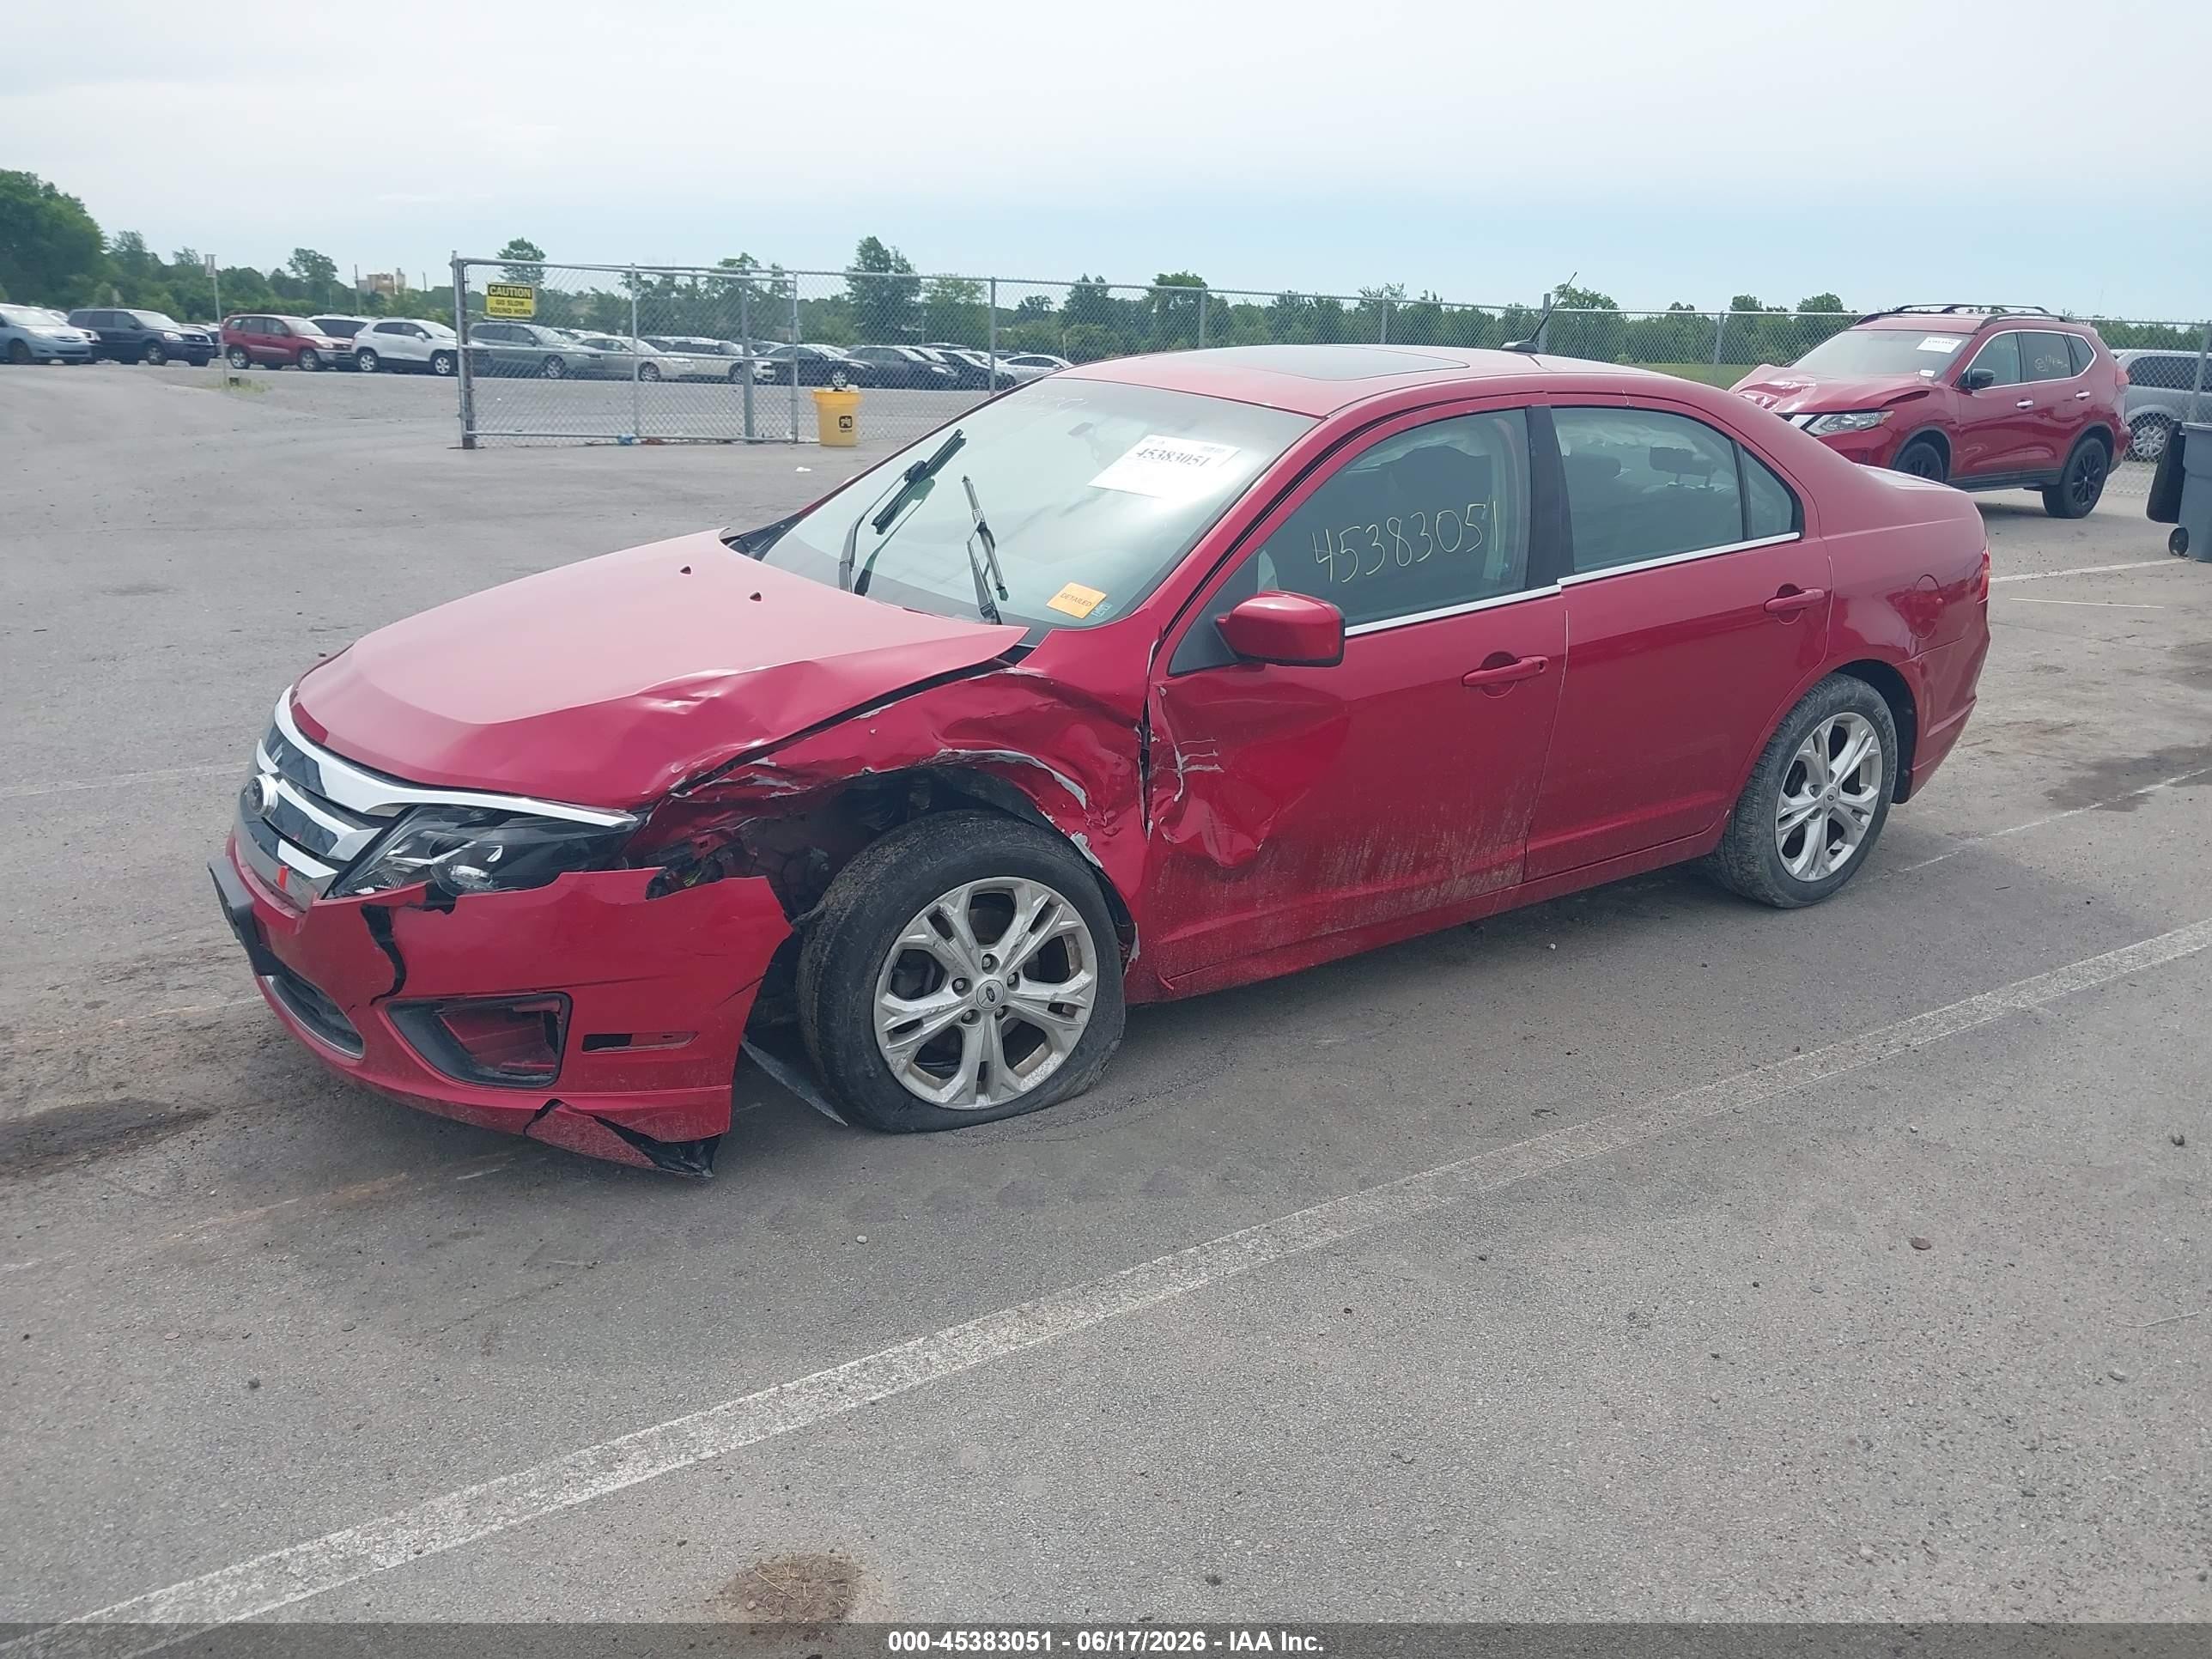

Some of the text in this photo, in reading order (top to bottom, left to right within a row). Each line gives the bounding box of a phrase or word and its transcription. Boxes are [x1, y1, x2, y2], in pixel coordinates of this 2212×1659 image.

[489, 286, 531, 298] CAUTION
[1137, 447, 1212, 467] 45383051
[1312, 501, 1498, 583] 45383051
[1060, 592, 1092, 607] DETAILED
